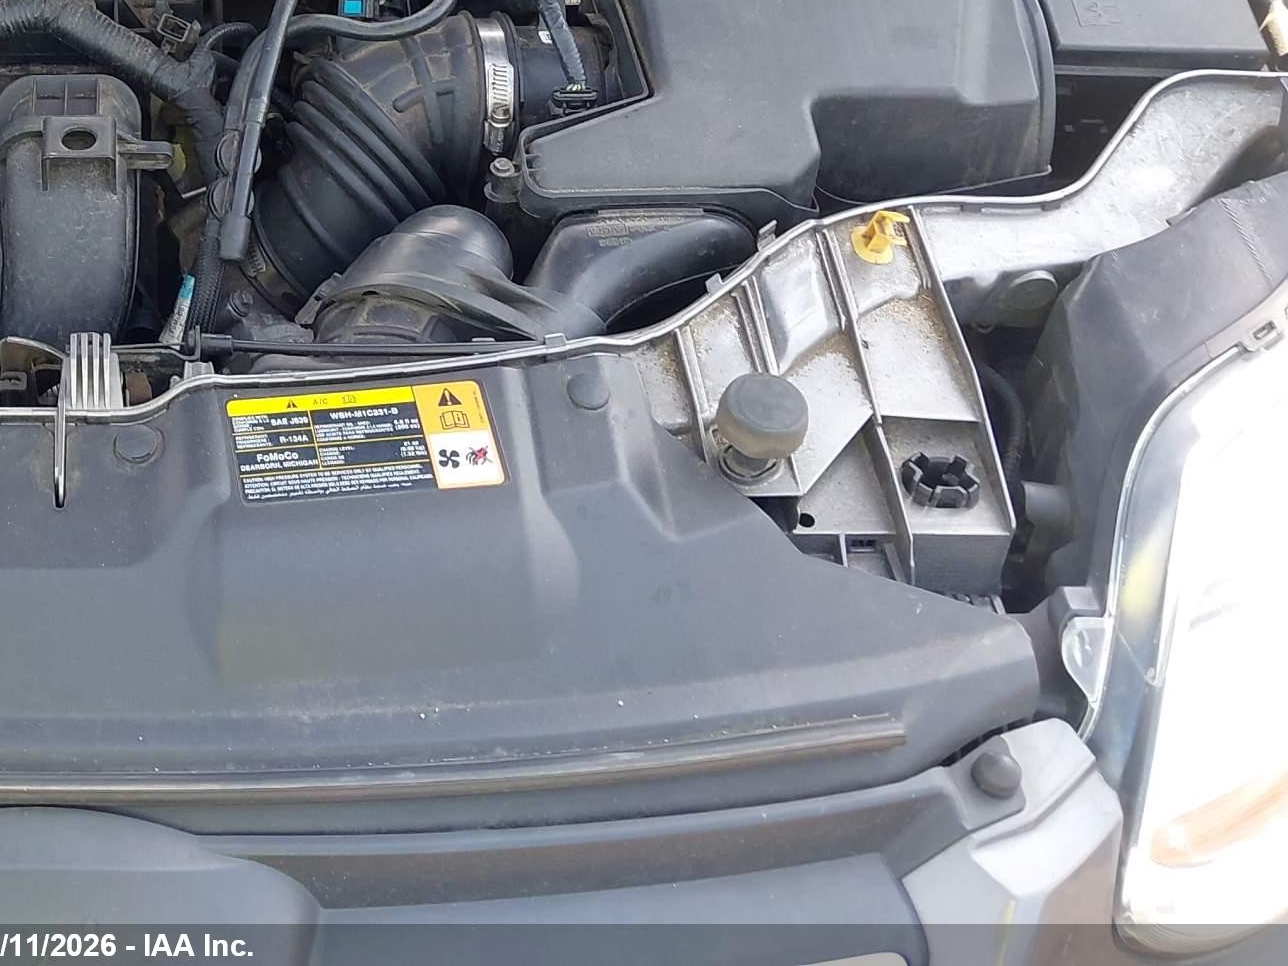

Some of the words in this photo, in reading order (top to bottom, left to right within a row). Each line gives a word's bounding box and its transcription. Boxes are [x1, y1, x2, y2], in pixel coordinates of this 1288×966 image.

[278, 434, 309, 444] R-134A
[256, 451, 299, 463] FoMoCo
[282, 458, 319, 468] MICHIGAN
